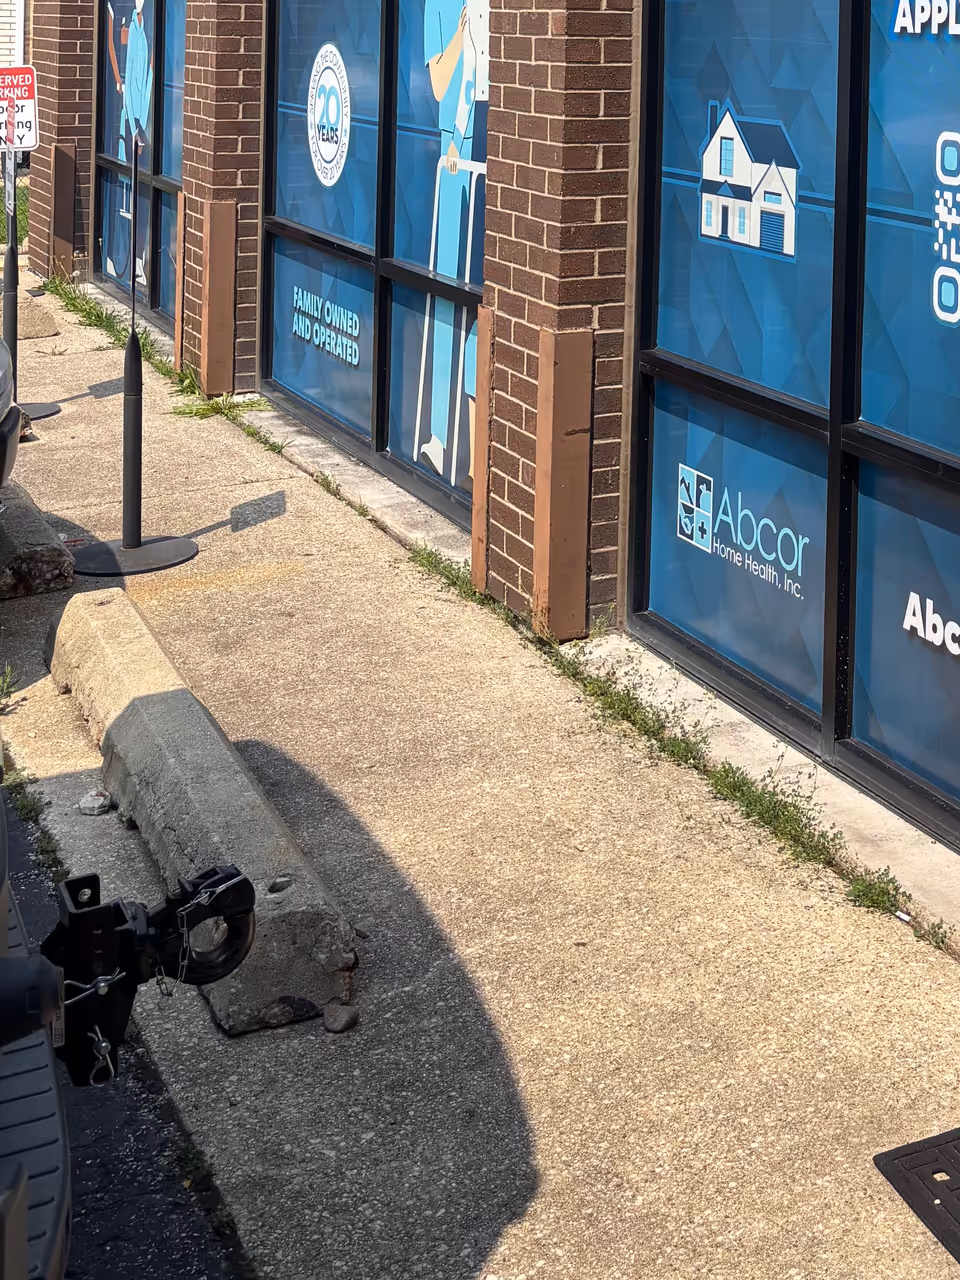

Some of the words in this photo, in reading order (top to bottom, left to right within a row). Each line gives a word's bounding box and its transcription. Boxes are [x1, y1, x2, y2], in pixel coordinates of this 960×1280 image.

[318, 84, 340, 124] 20
[317, 124, 338, 145] YEARS
[294, 286, 323, 319] FAMILY
[324, 301, 360, 337] OWNED
[293, 313, 311, 340] AND
[313, 323, 360, 366] OPERATED
[714, 486, 809, 576] Abcor
[713, 536, 742, 565] Home
[745, 553, 781, 589] Health,
[784, 576, 803, 600] Inc.
